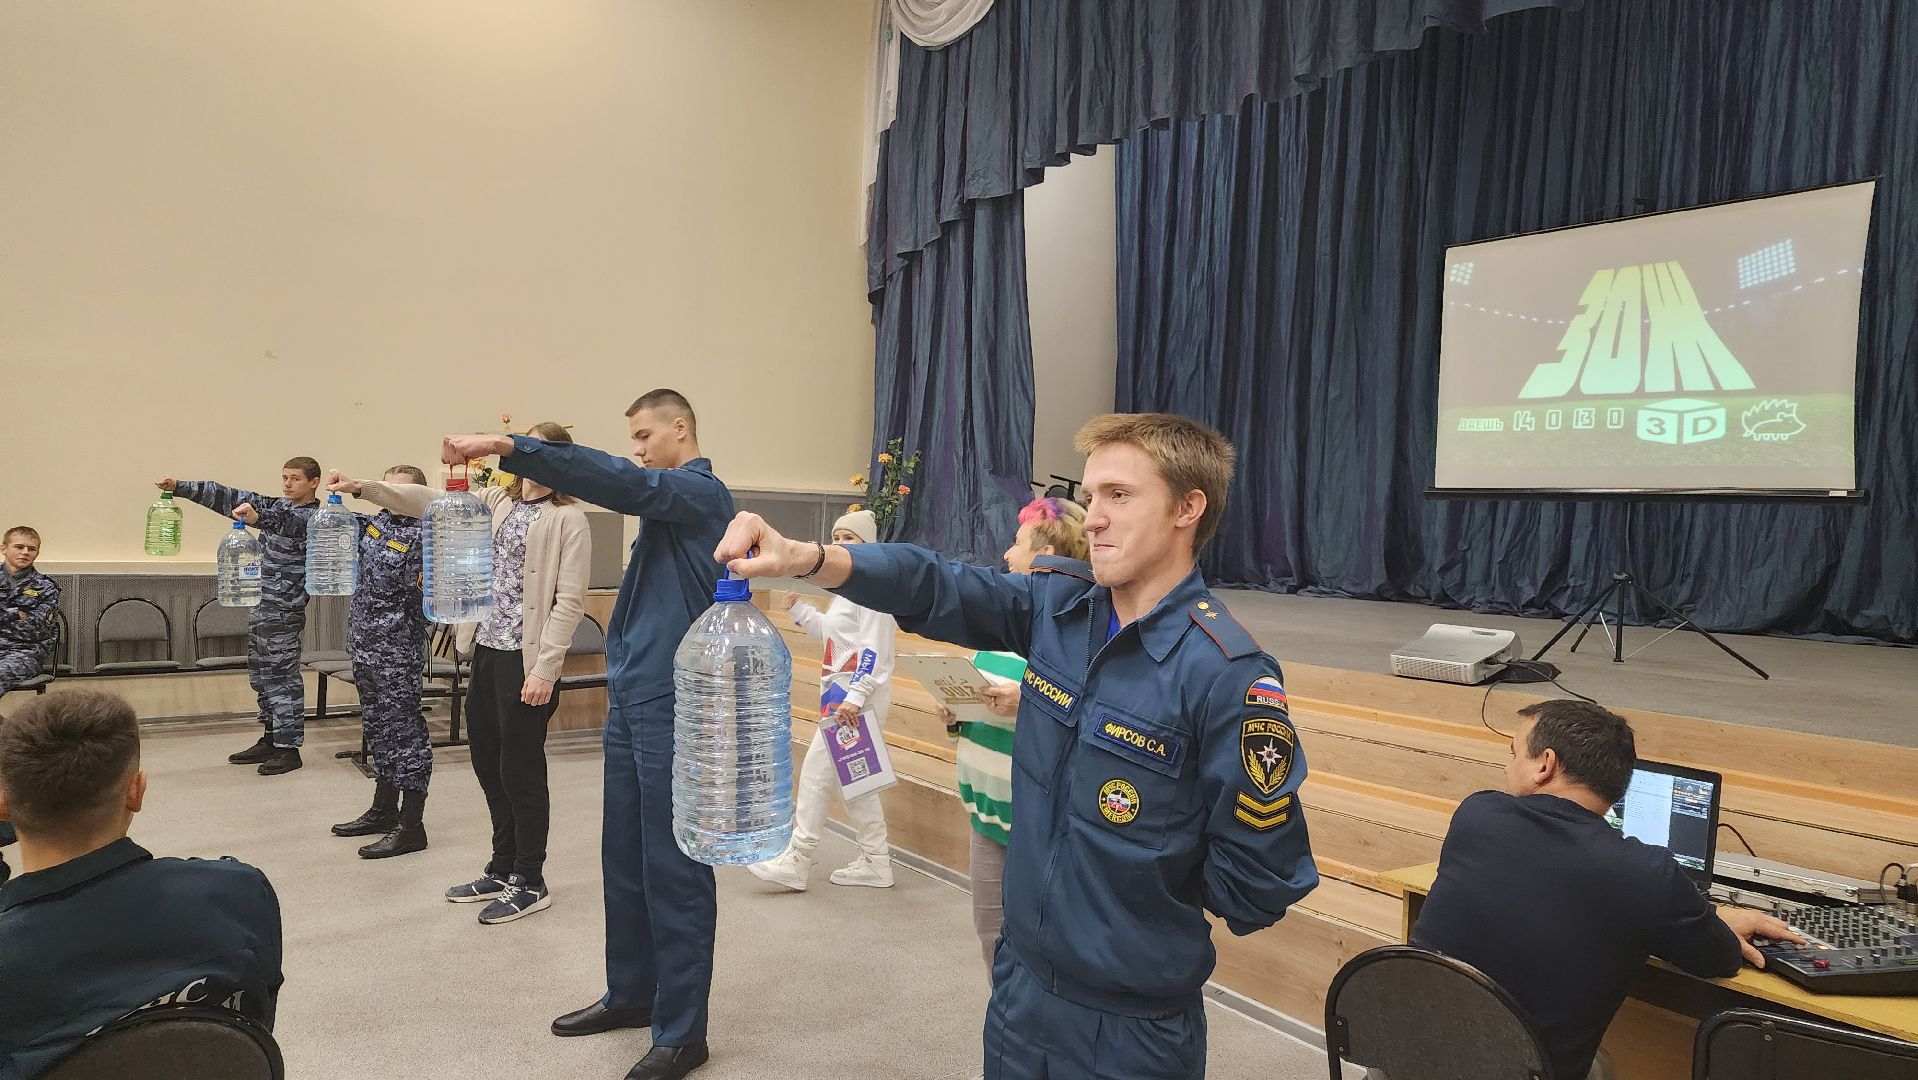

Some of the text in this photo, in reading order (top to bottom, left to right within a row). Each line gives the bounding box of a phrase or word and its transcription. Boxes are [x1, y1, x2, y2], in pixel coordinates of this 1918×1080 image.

[1517, 260, 1757, 399] ЗОЖ
[1033, 675, 1073, 709] РОССИИ
[1256, 695, 1286, 709] RUSSIA
[1105, 722, 1166, 757] ФИРСОВ С.А.
[1246, 722, 1292, 740] МЧС РОССИИ
